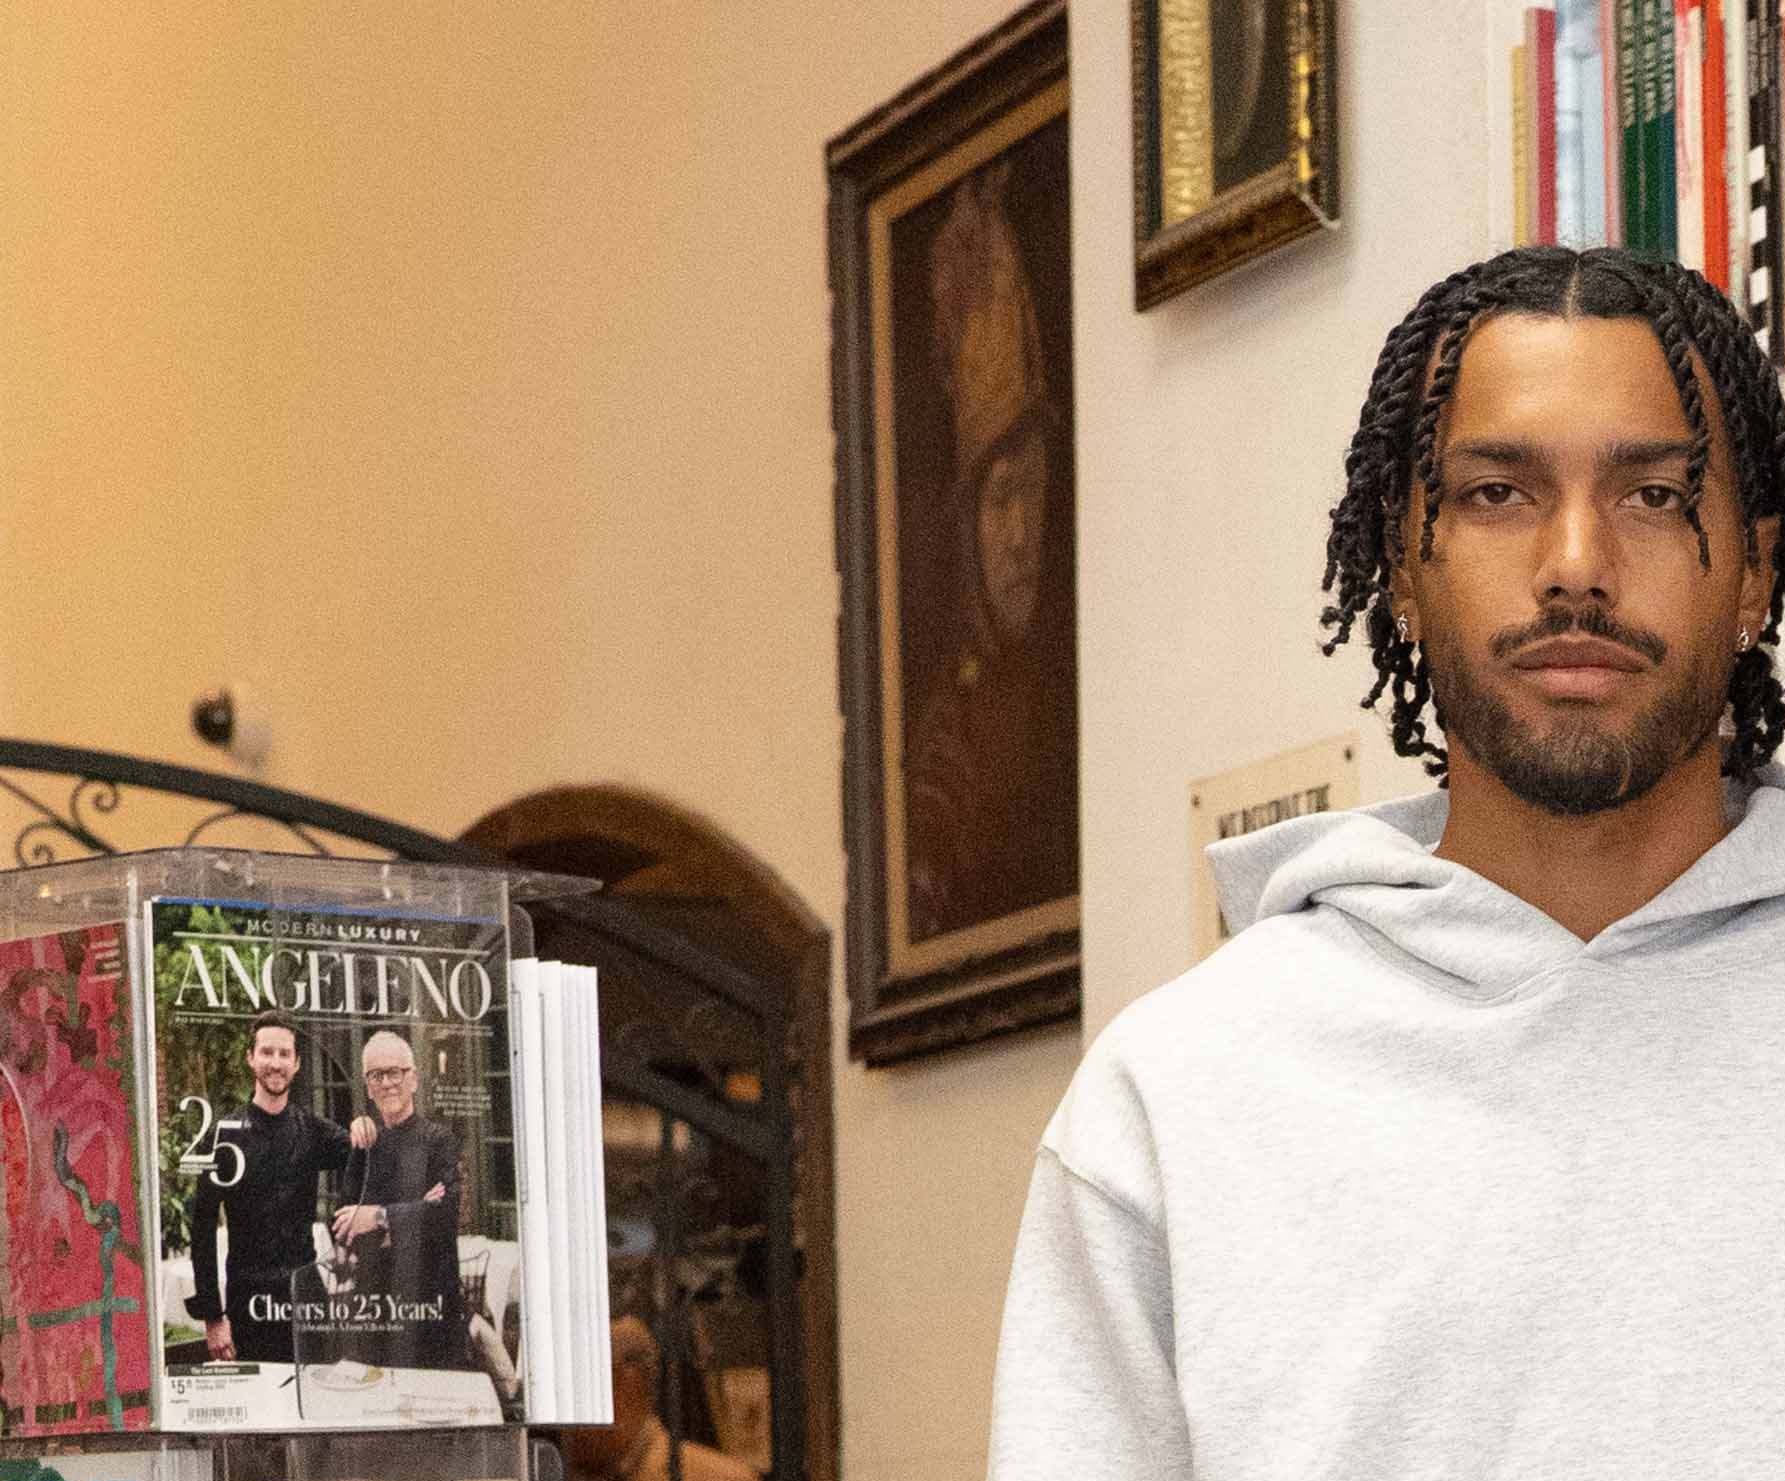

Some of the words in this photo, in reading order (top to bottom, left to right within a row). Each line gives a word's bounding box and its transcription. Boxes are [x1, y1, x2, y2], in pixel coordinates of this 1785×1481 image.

[175, 943, 492, 1021] ANGELENO
[178, 1095, 246, 1188] 25
[248, 1294, 323, 1322] Cheers
[328, 1295, 348, 1321] to
[352, 1295, 382, 1321] 25
[386, 1293, 443, 1321] Years!
